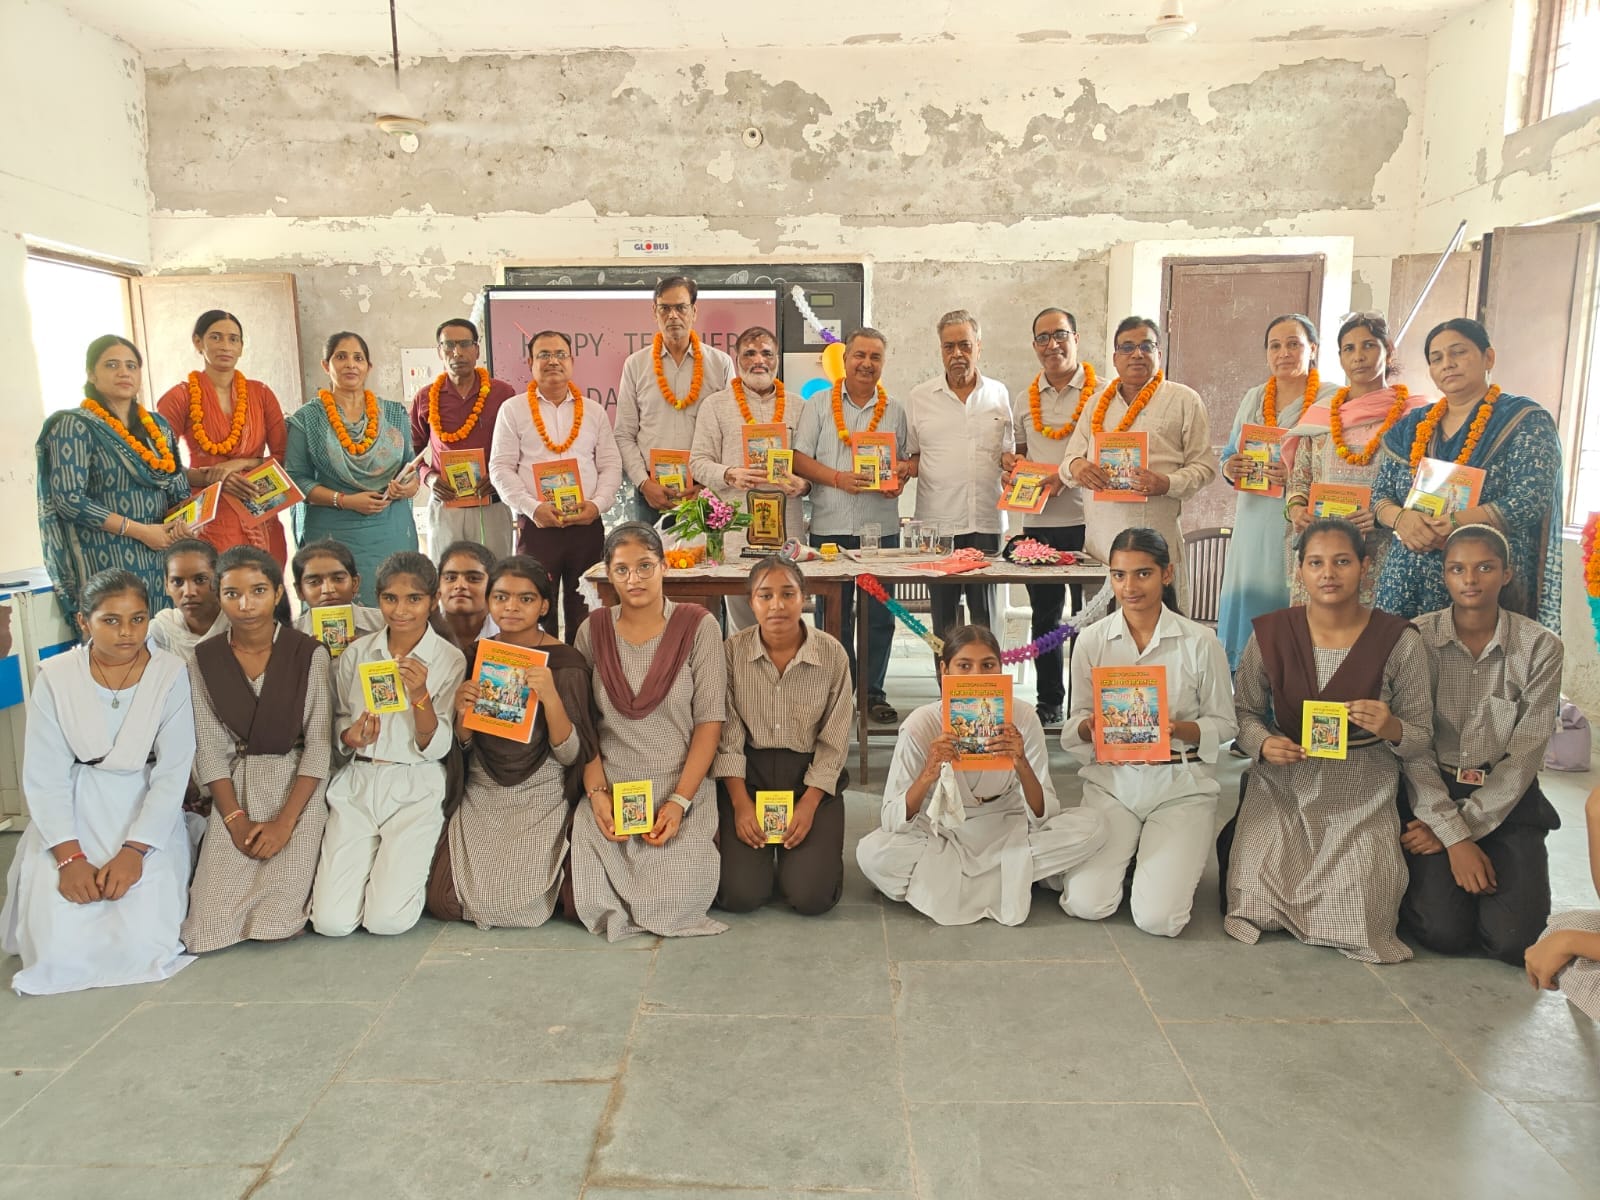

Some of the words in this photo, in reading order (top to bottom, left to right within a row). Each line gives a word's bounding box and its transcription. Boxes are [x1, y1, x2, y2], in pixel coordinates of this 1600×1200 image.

[634, 243, 669, 251] GLOBUS
[522, 333, 603, 357] HPY
[587, 387, 618, 411] DA
